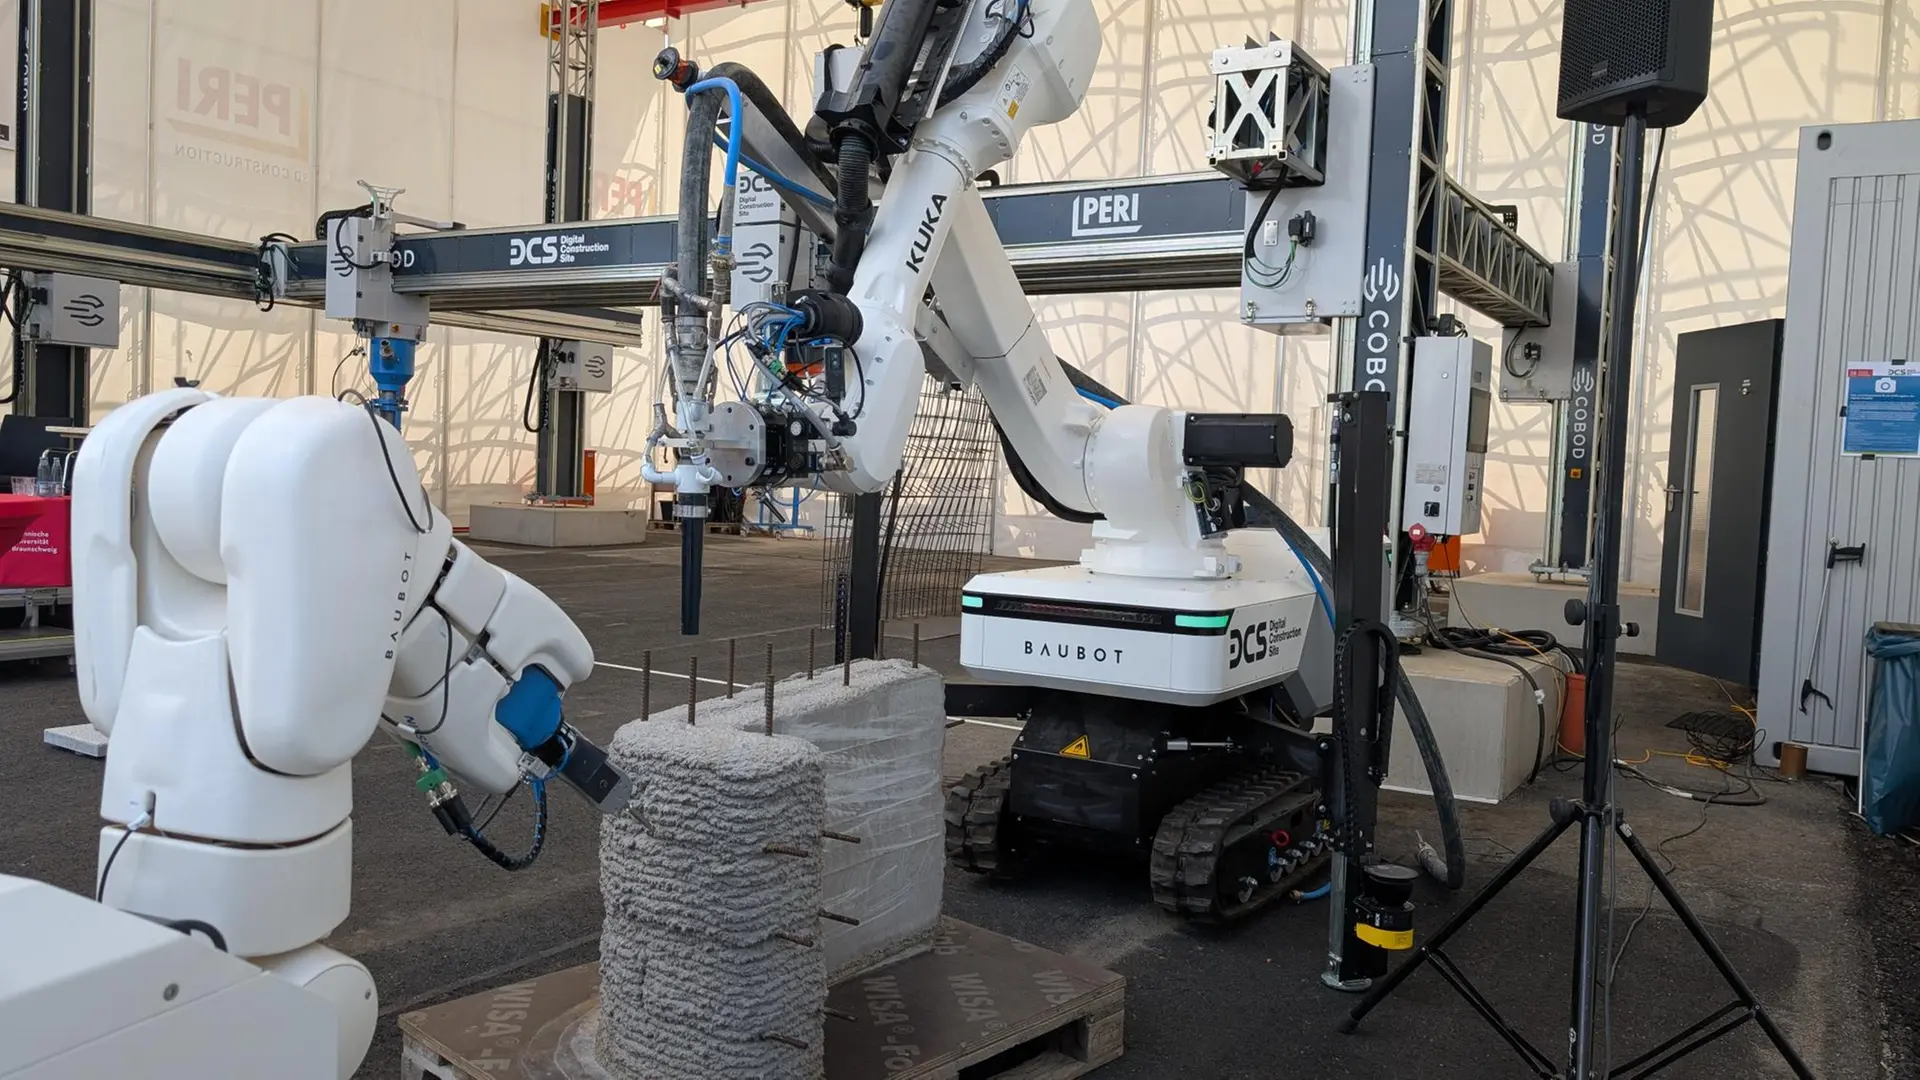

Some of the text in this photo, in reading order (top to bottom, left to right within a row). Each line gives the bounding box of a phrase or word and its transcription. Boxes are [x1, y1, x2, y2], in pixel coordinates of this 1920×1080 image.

[739, 202, 774, 210] Construction
[1082, 193, 1139, 225] PERI
[560, 234, 585, 246] Digital
[905, 193, 948, 274] KUKA
[510, 236, 558, 266] DCS
[559, 253, 575, 263] Site
[560, 243, 610, 254] Construction
[1572, 396, 1588, 459] COBOD
[385, 552, 412, 659] BAUBOT
[1269, 616, 1287, 633] Digital
[1229, 621, 1268, 670] DCS
[1269, 627, 1302, 644] Construction
[1024, 640, 1123, 664] BAUBOT
[1269, 645, 1280, 657] Site
